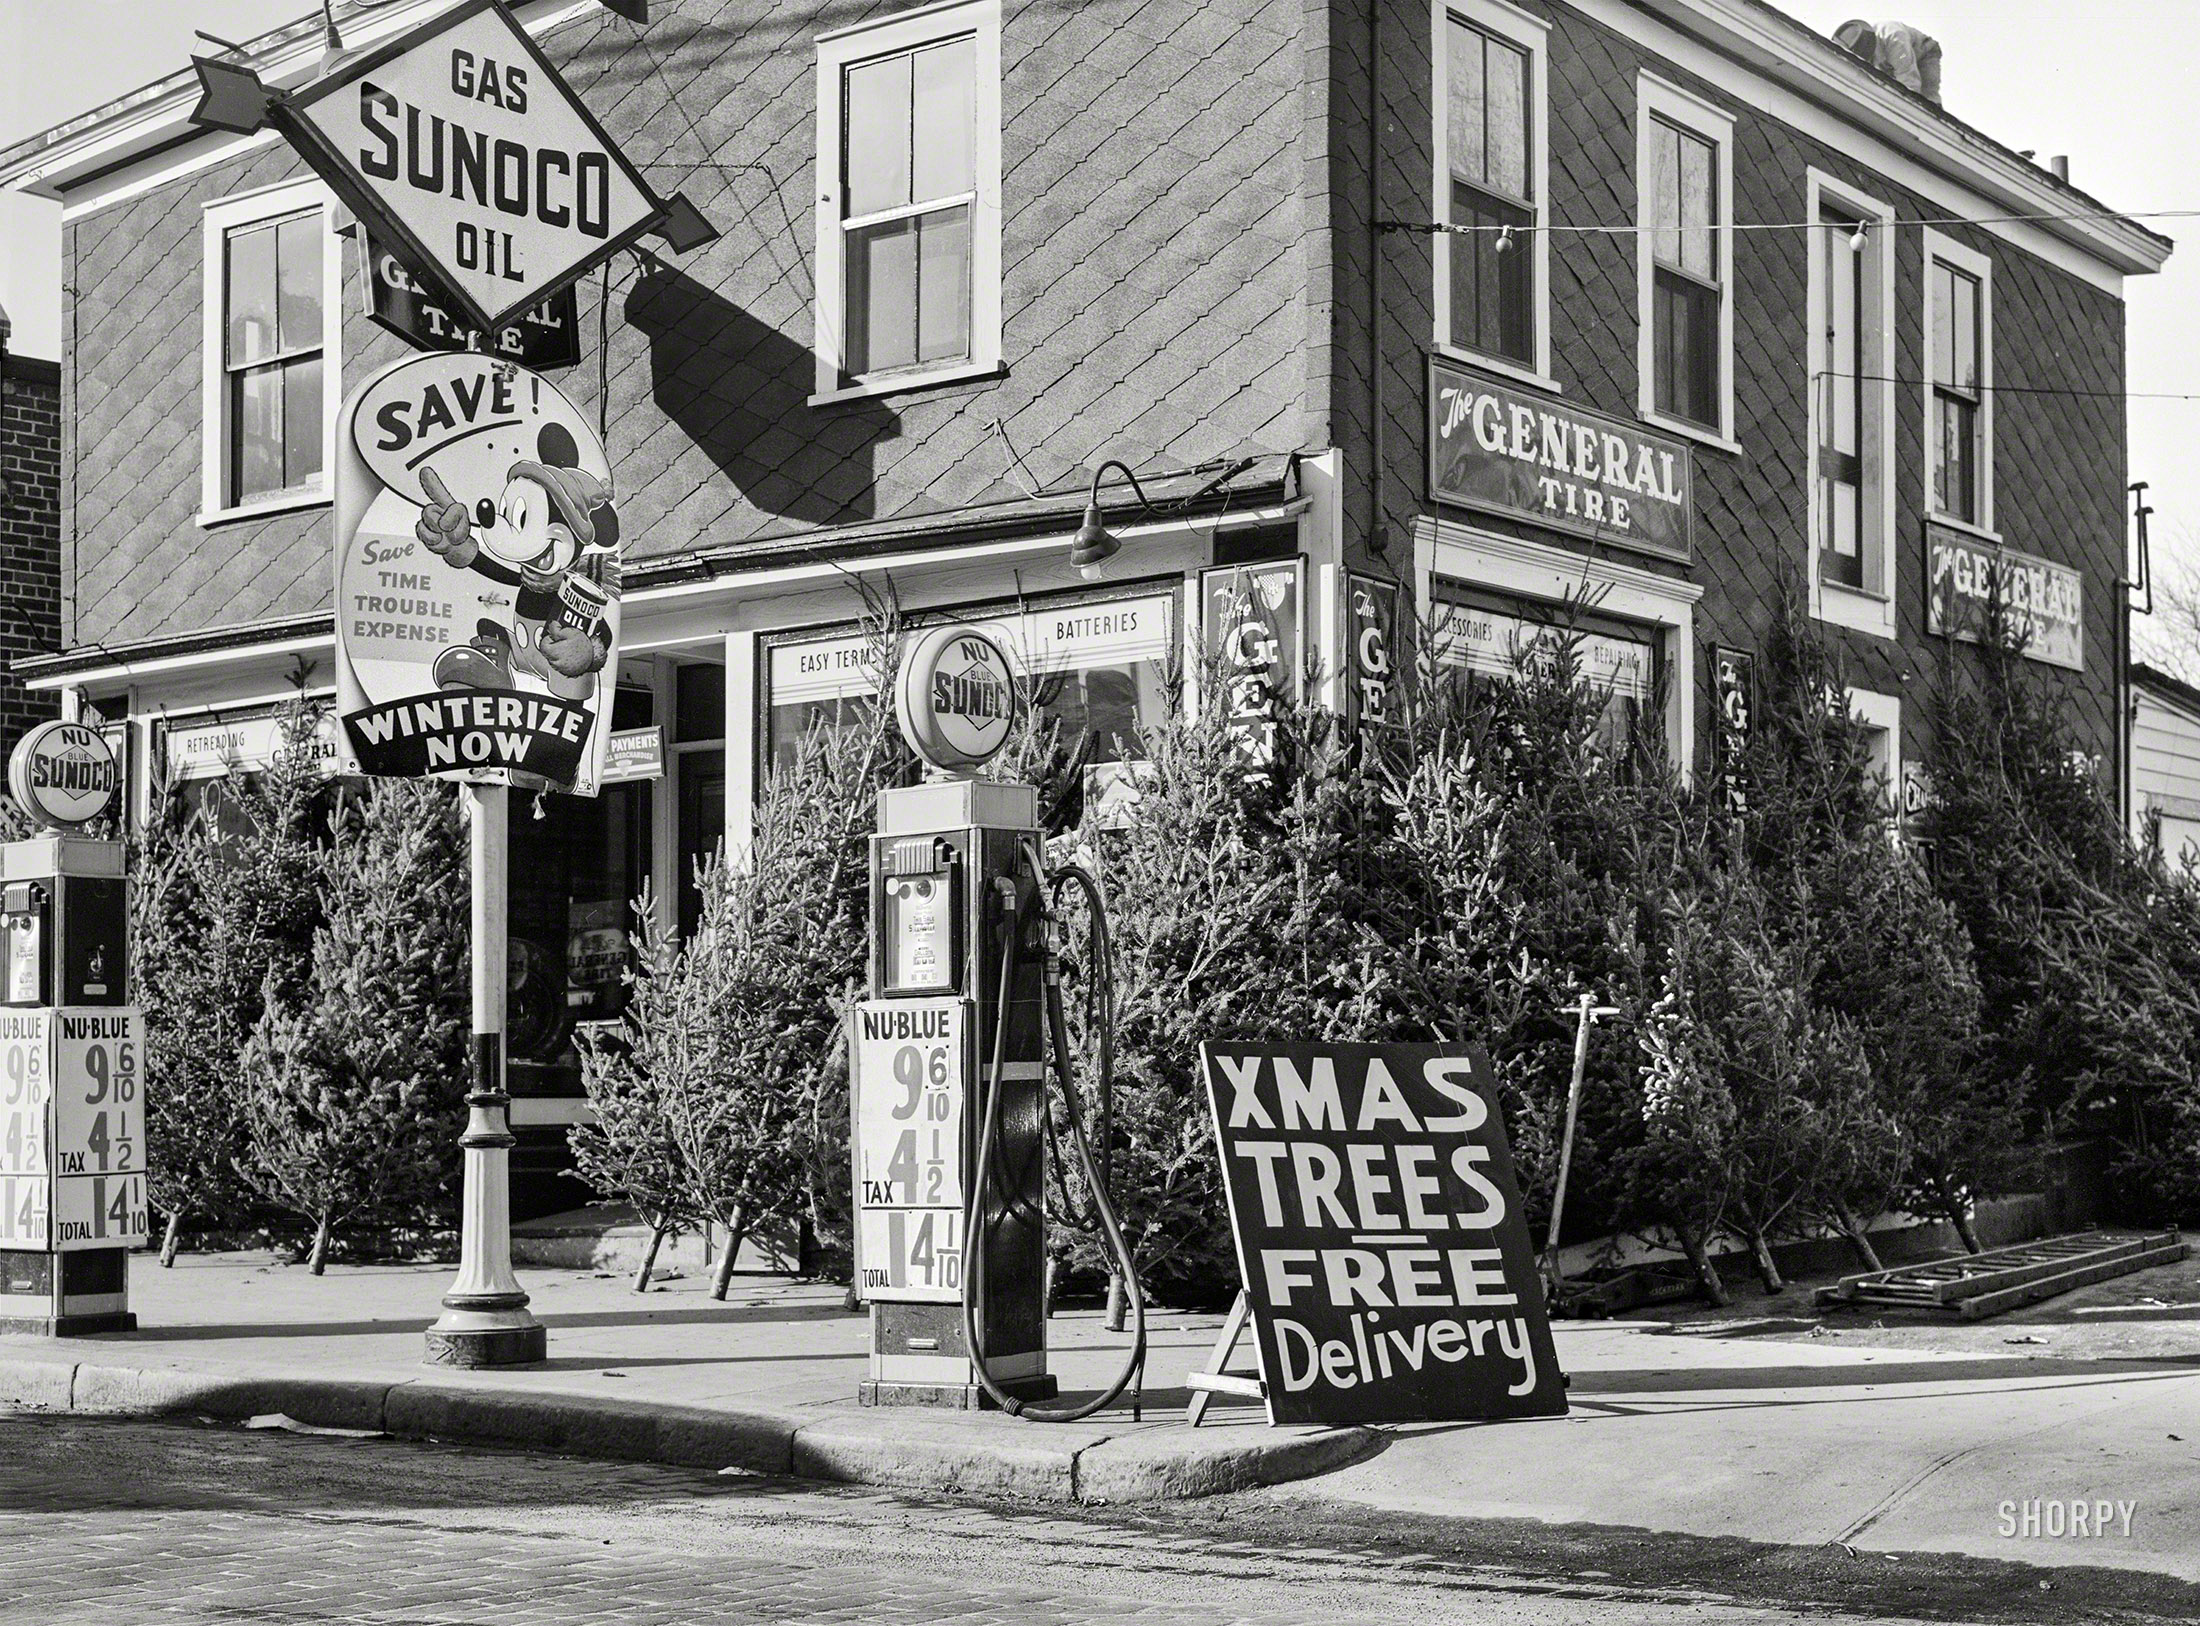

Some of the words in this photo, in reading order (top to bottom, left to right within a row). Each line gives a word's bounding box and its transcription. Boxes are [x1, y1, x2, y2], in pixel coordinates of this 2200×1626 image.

[452, 48, 527, 115] GAS
[360, 82, 609, 240] SUNOCO
[456, 221, 524, 283] OIL
[1441, 388, 1474, 439] The
[1472, 394, 1683, 506] GENERAL
[1538, 475, 1630, 529] TIRE
[361, 539, 415, 566] Save
[377, 570, 431, 591] TIME
[354, 595, 452, 619] TROUBLE
[563, 587, 600, 618] SUNOCO
[563, 609, 584, 630] OIL
[1353, 589, 1376, 619] The
[354, 620, 450, 644] EXPENSE
[1057, 612, 1137, 640] BATTERIES
[801, 653, 829, 673] EASY
[961, 641, 990, 662] NU
[970, 670, 992, 681] BLUE
[61, 729, 91, 746] NU
[355, 696, 584, 746] WINTERIZE
[68, 752, 88, 761] BLUE
[187, 731, 245, 754] RETREADING
[426, 731, 533, 767] NOW
[611, 734, 658, 753] PAYMENTS
[34, 752, 112, 793] SUNOCO
[6, 1044, 24, 1105] 9
[85, 1044, 109, 1104] 9
[891, 1045, 924, 1120] 9
[1215, 1055, 1488, 1133] XMAS
[6, 1111, 22, 1171] 4
[60, 1151, 85, 1173] TAX
[88, 1111, 110, 1171] 4
[862, 1180, 894, 1204] TAX
[887, 1129, 919, 1204] 4
[1234, 1141, 1506, 1230] TREES
[59, 1221, 92, 1241] TOTAL
[862, 1268, 891, 1288] TOTAL
[1260, 1248, 1518, 1307] FREE
[1273, 1311, 1537, 1396] Delivery
